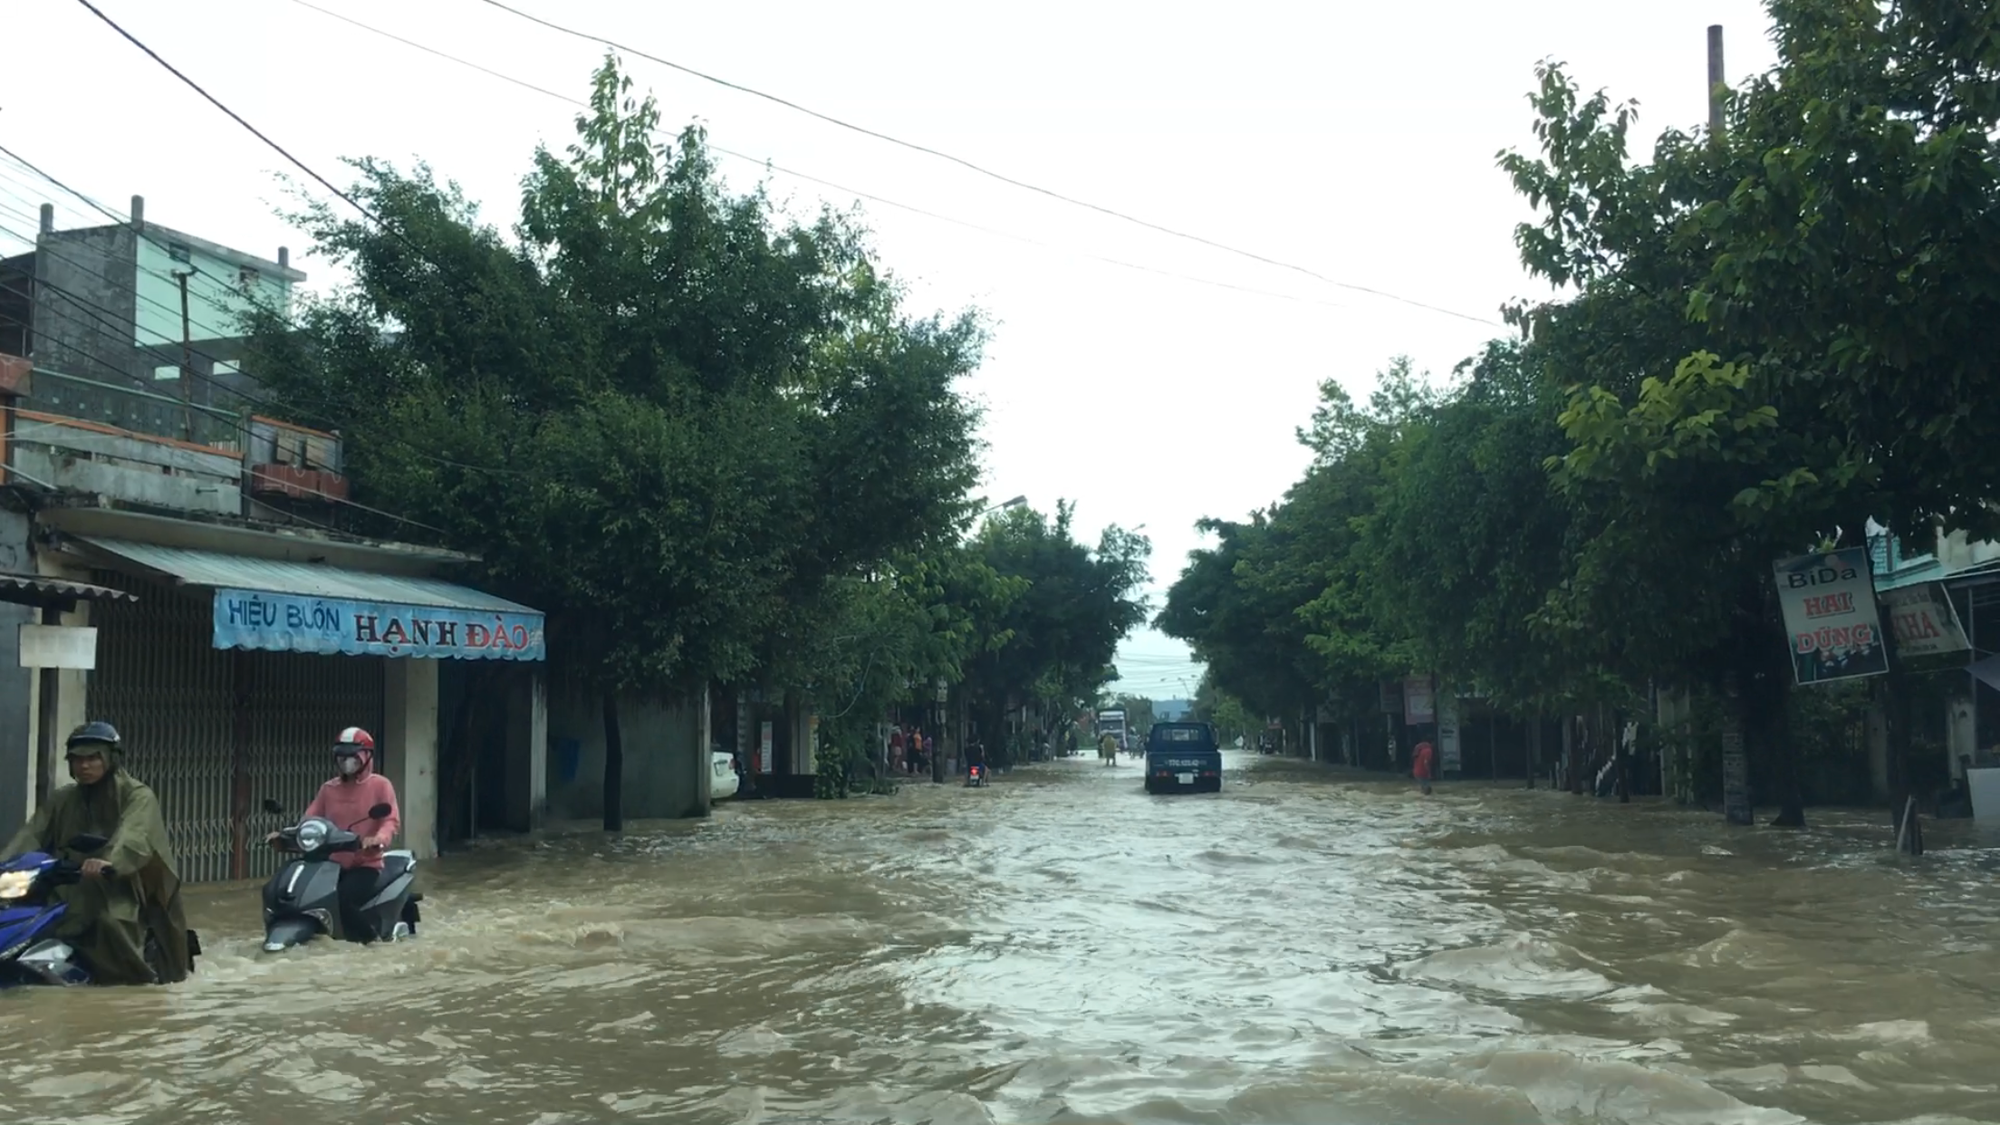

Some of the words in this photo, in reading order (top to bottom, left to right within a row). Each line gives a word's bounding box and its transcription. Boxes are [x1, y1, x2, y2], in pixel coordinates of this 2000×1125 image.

[1788, 567, 1858, 589] BiDa
[1803, 592, 1854, 618] HAI
[228, 594, 276, 631] HIỆU
[353, 612, 458, 651] HẠNH
[464, 614, 529, 650] ĐÀO
